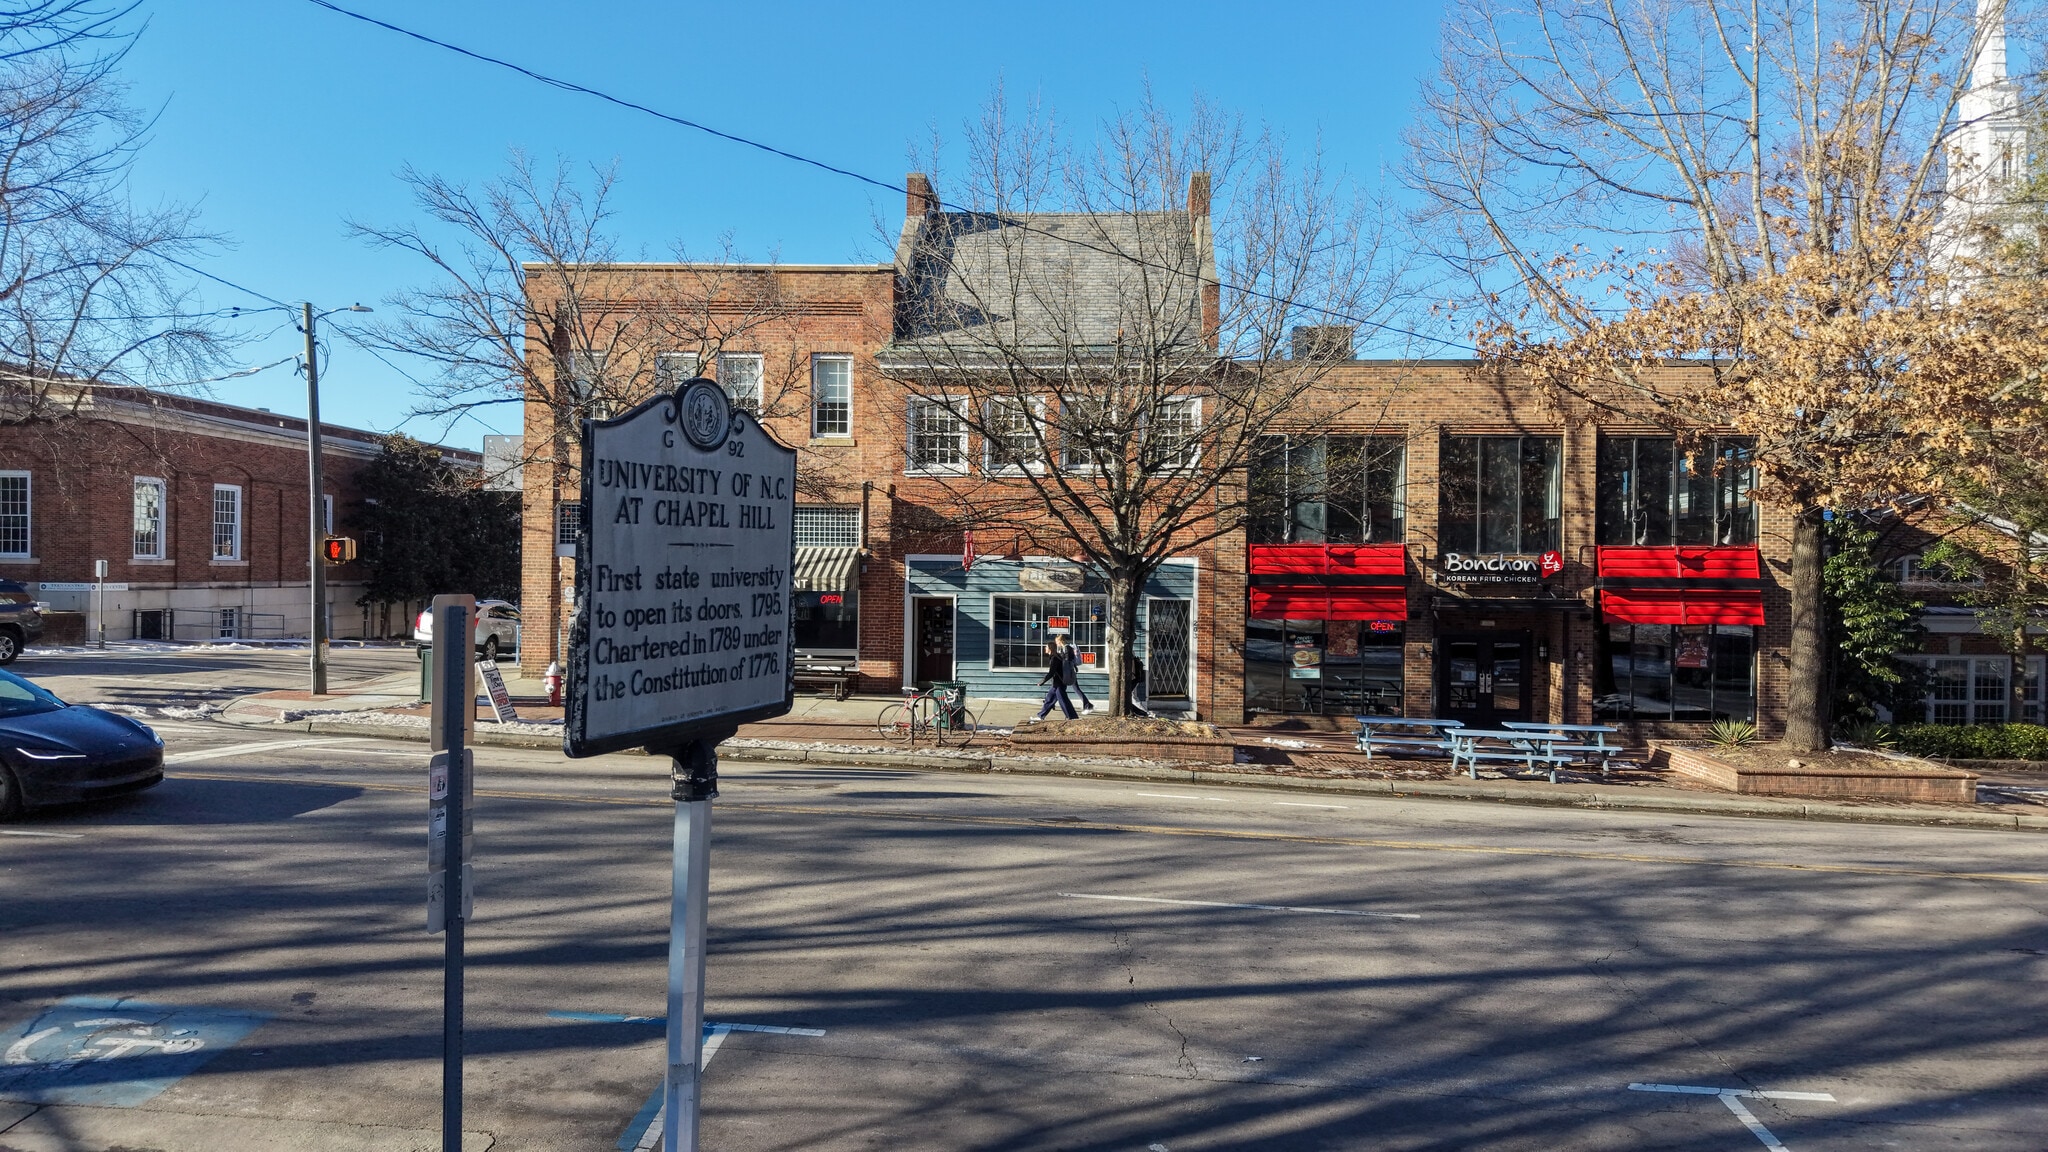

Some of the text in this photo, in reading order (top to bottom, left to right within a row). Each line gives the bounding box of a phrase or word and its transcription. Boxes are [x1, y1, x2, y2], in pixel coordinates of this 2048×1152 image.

[663, 430, 674, 448] G
[728, 440, 745, 458] 92
[599, 458, 787, 500] UNIVERSITY OF N.C.
[614, 495, 775, 529] AT CHAPEL HILL
[1445, 553, 1537, 571] Bonchon
[596, 564, 784, 592] First state university
[596, 602, 617, 629] to
[624, 607, 666, 632] open
[671, 598, 692, 624] its
[751, 592, 783, 618] 1795.
[820, 595, 842, 604] OPEN
[1370, 622, 1395, 631] OPEN
[596, 624, 782, 665] Chartered in 1789 under
[595, 652, 780, 701] the Constitution of 1776.
